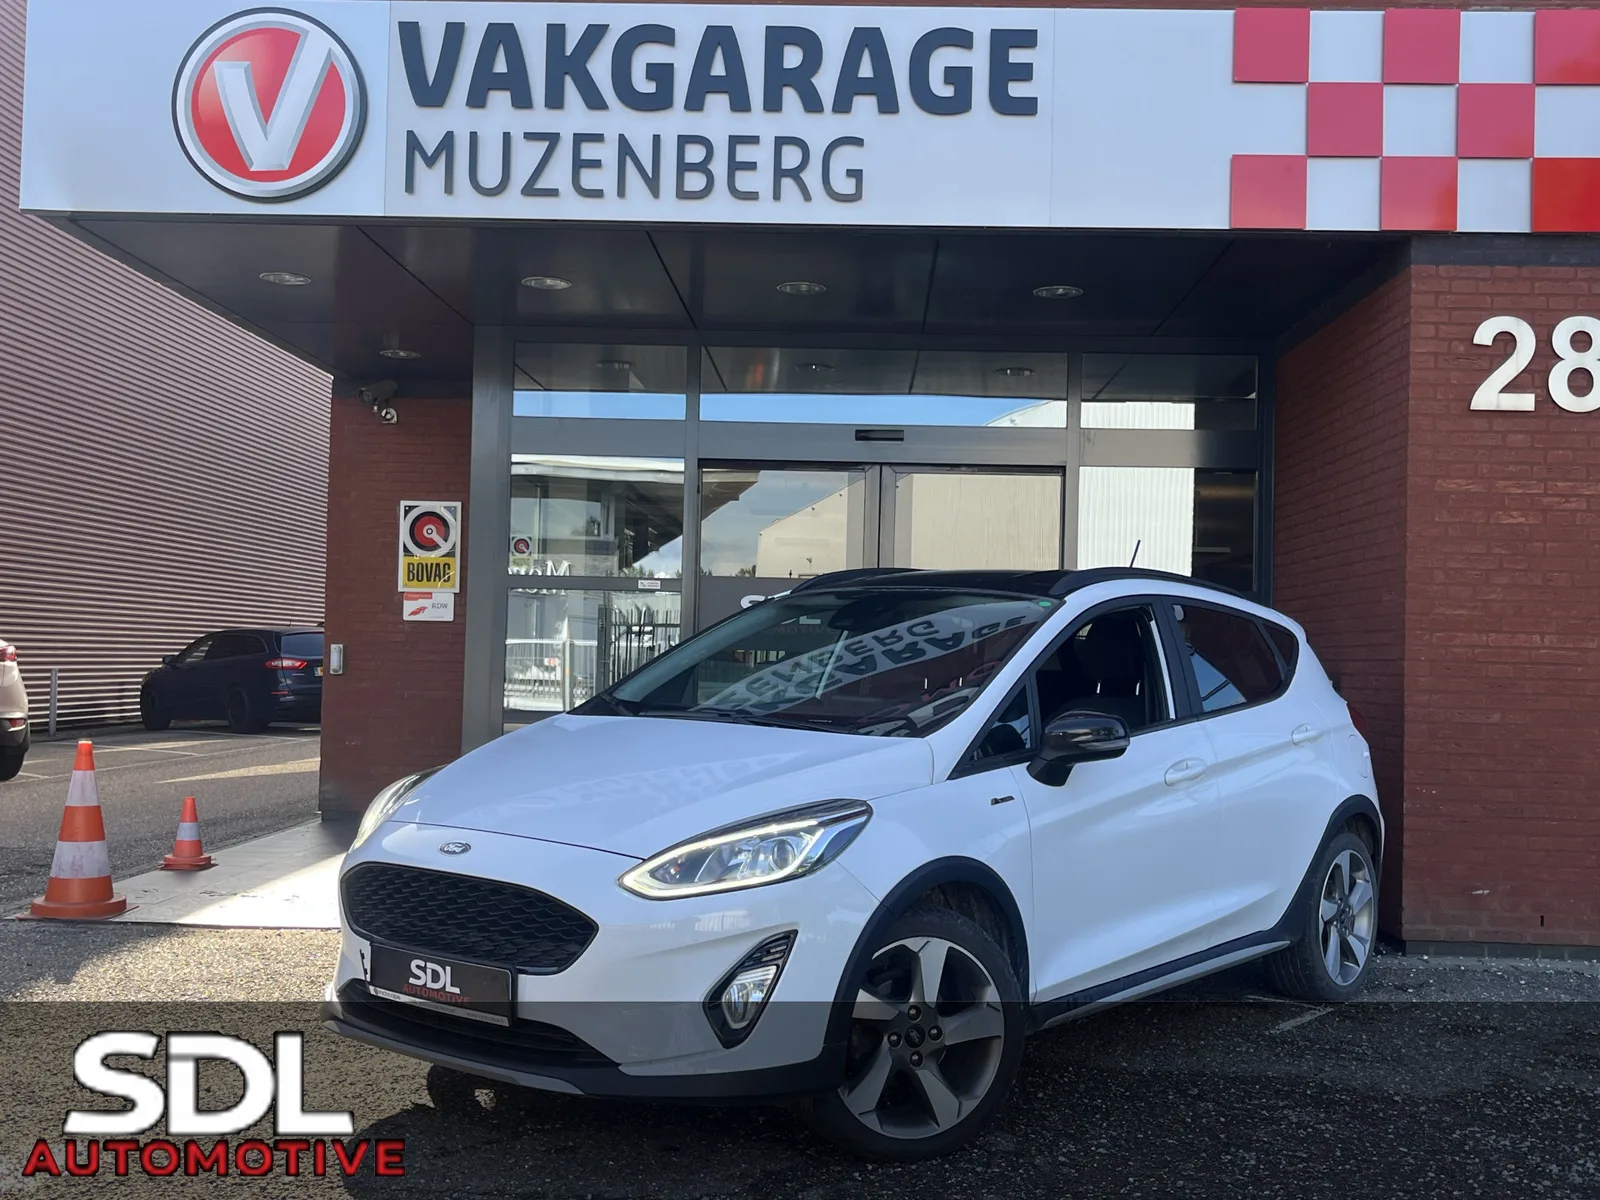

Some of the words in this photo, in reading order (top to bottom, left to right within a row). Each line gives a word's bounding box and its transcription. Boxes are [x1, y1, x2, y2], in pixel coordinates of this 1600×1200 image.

[212, 28, 333, 172] V
[397, 21, 1039, 116] VAKGARAGE
[404, 129, 865, 203] MUZENBERG
[1470, 315, 1600, 413] 28
[407, 562, 451, 583] BOVAG
[402, 983, 471, 1005] AUTOMOTIVE
[408, 958, 460, 994] SDL
